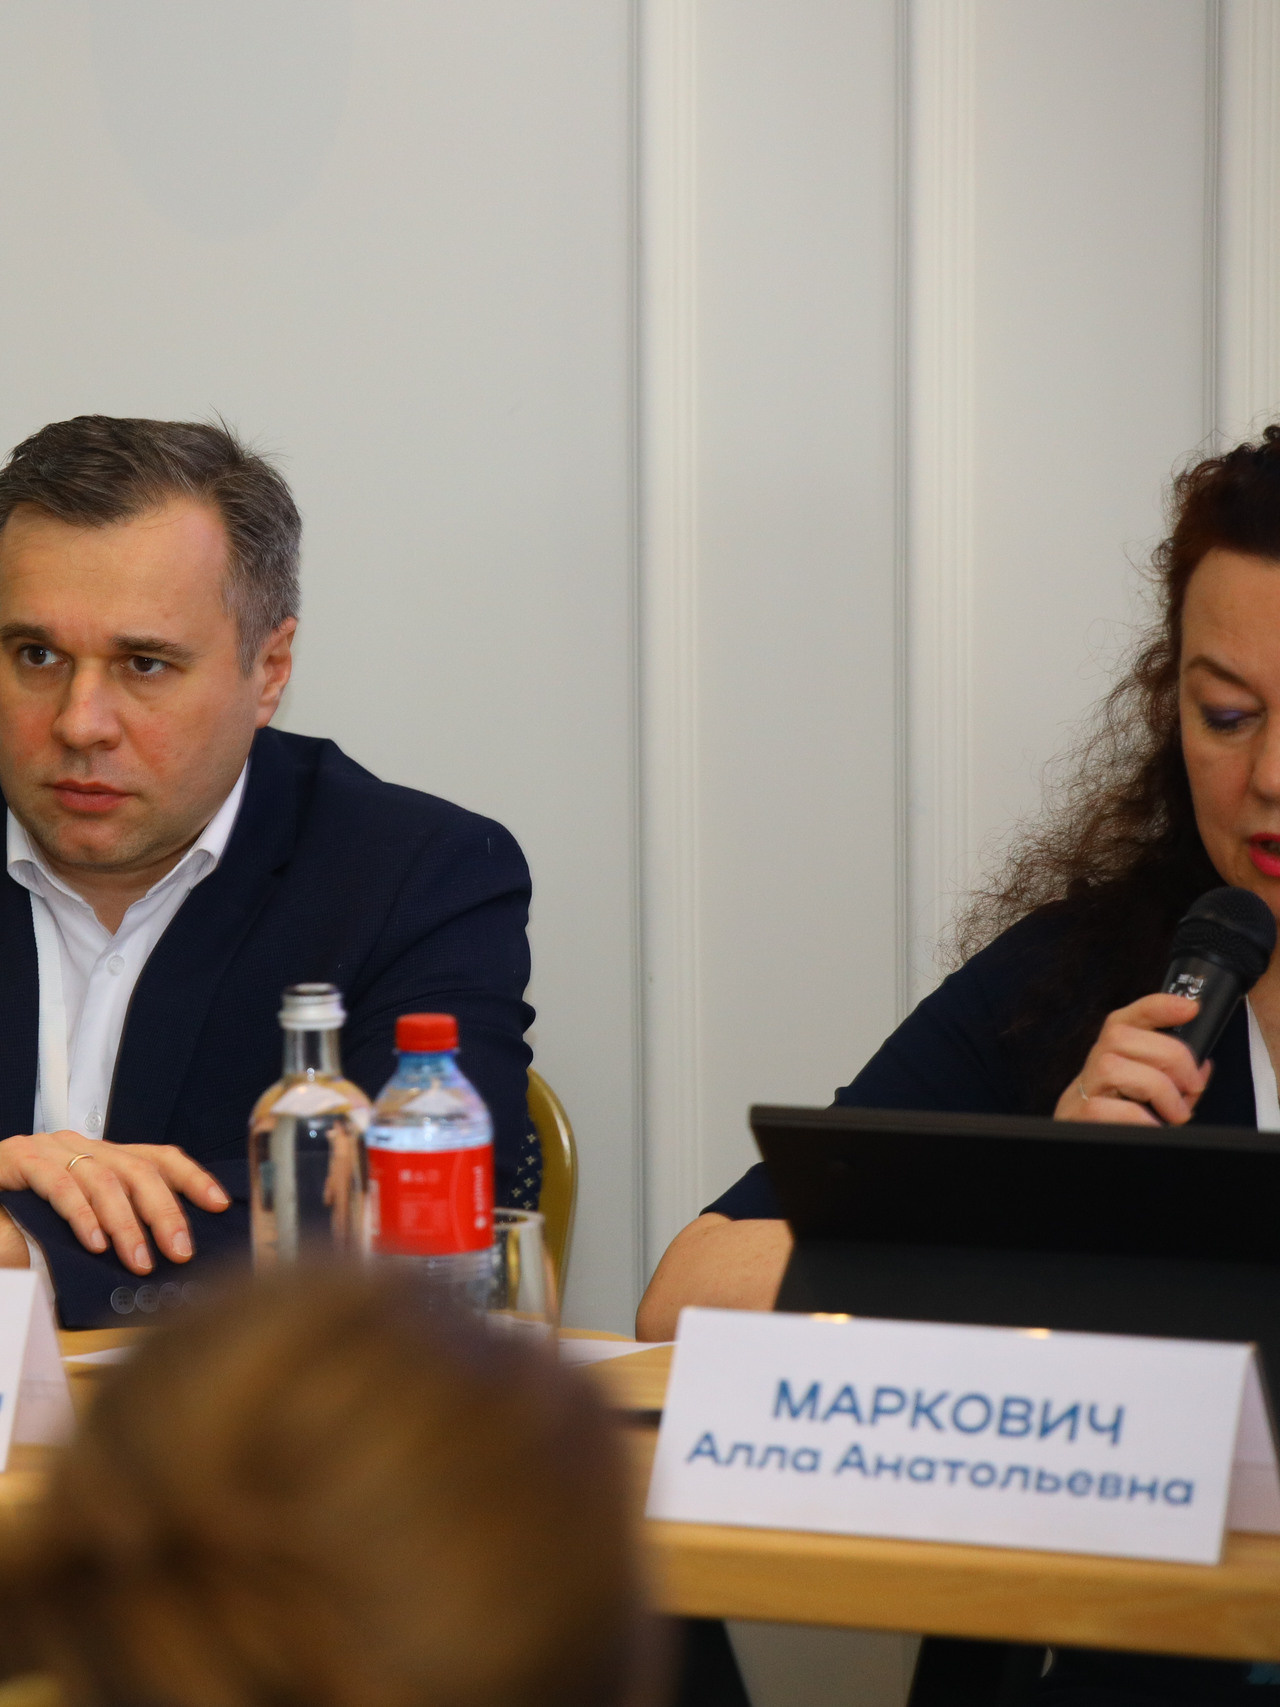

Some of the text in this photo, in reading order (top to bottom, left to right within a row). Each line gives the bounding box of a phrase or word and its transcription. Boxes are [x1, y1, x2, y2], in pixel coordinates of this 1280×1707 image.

[773, 1379, 1125, 1446] МАРКОВИЧ
[687, 1432, 1195, 1506] Алла Анатольевна
